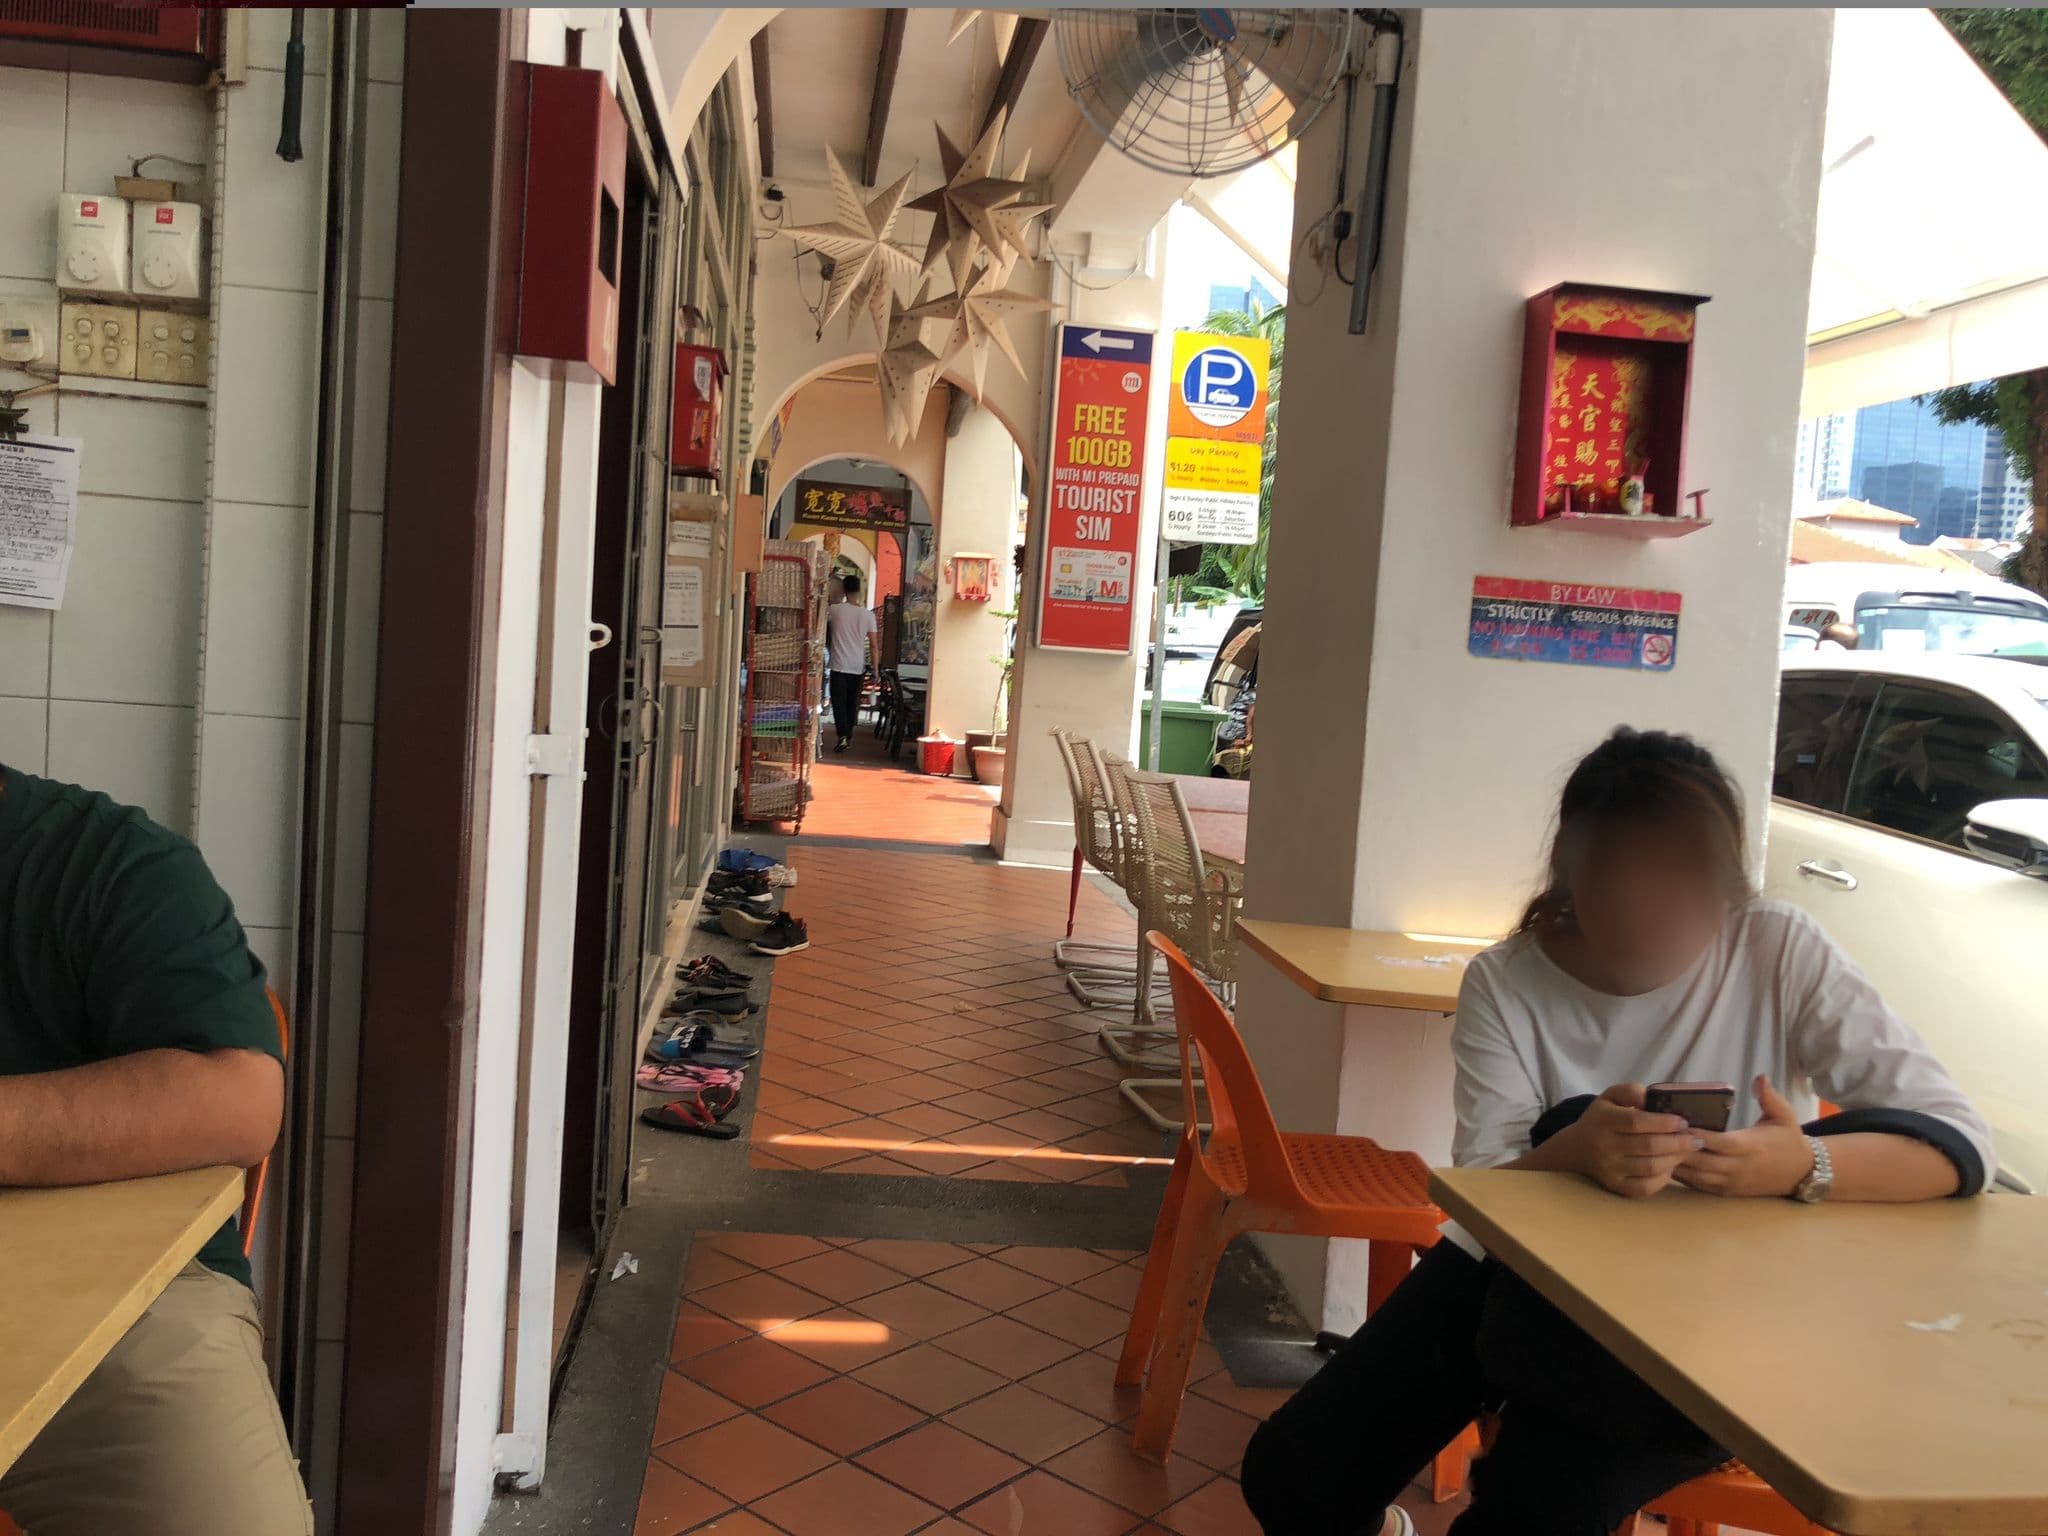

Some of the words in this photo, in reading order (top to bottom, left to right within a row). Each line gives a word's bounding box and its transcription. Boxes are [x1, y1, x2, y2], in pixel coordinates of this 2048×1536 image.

[1199, 354, 1243, 403] P
[1074, 404, 1127, 435] FREE
[1067, 436, 1132, 468] 100GB
[1056, 466, 1080, 481] WITH
[1082, 470, 1096, 482] M1
[1099, 471, 1139, 486] PREPAID
[1056, 485, 1136, 514] TOURIST
[1168, 510, 1193, 522] 60¢
[1075, 515, 1111, 541] SIM
[1551, 584, 1571, 600] BY
[1576, 587, 1616, 605] LAW
[1488, 604, 1554, 622] STRICTLY
[1571, 610, 1621, 626] SERIOUS
[1624, 615, 1676, 629] OFFENCE
